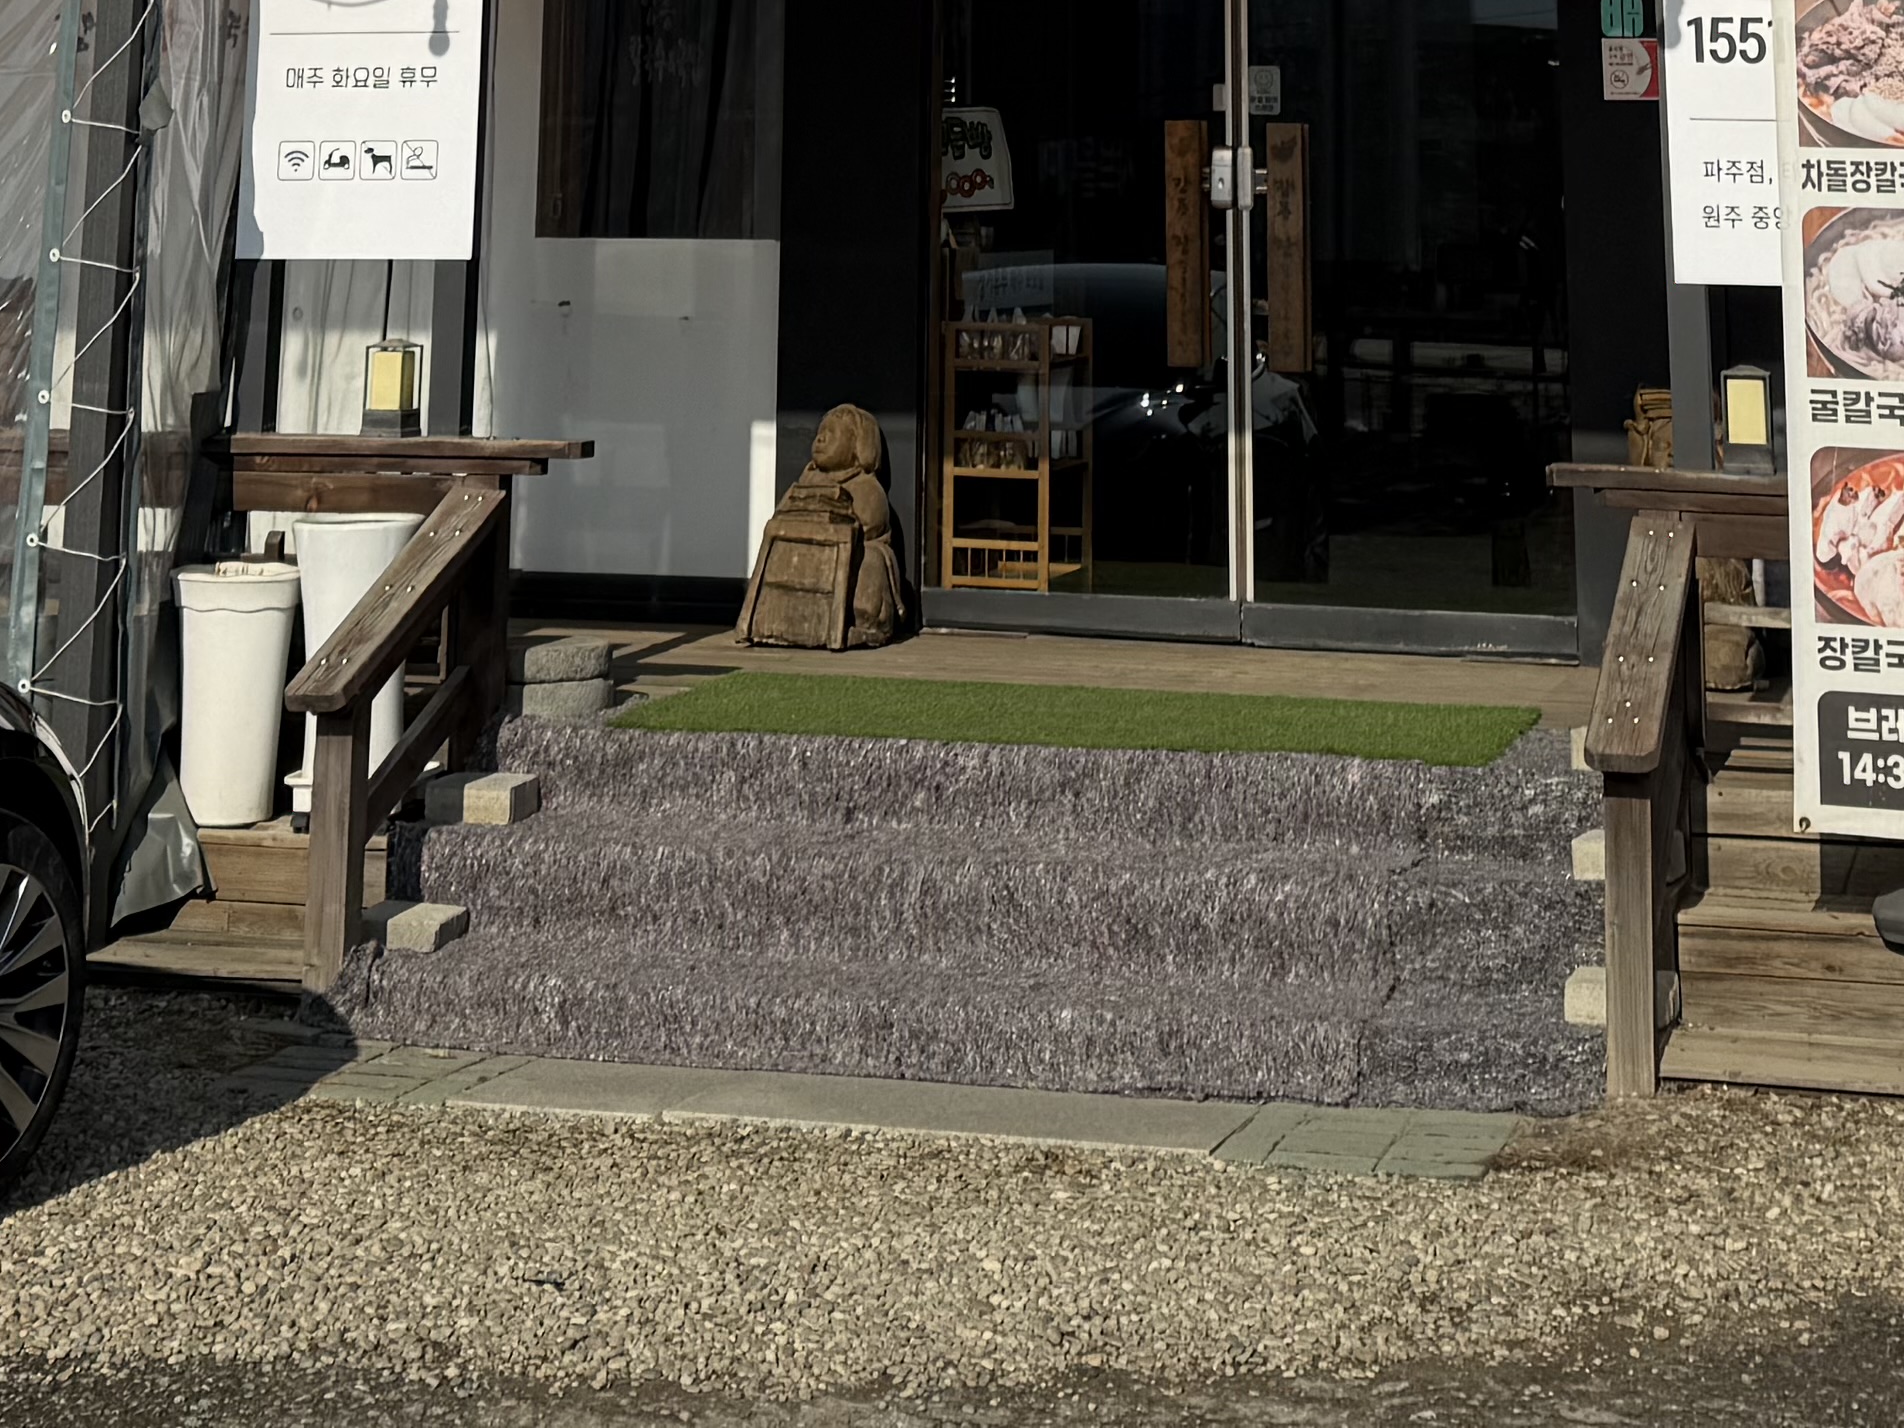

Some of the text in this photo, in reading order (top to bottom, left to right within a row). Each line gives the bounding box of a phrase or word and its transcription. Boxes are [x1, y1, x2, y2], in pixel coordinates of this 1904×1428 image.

[1687, 16, 1773, 64] 155
[286, 66, 438, 88] 매주 화요일 휴무
[1703, 159, 1773, 185] 파주점,
[1702, 204, 1743, 229] 원주
